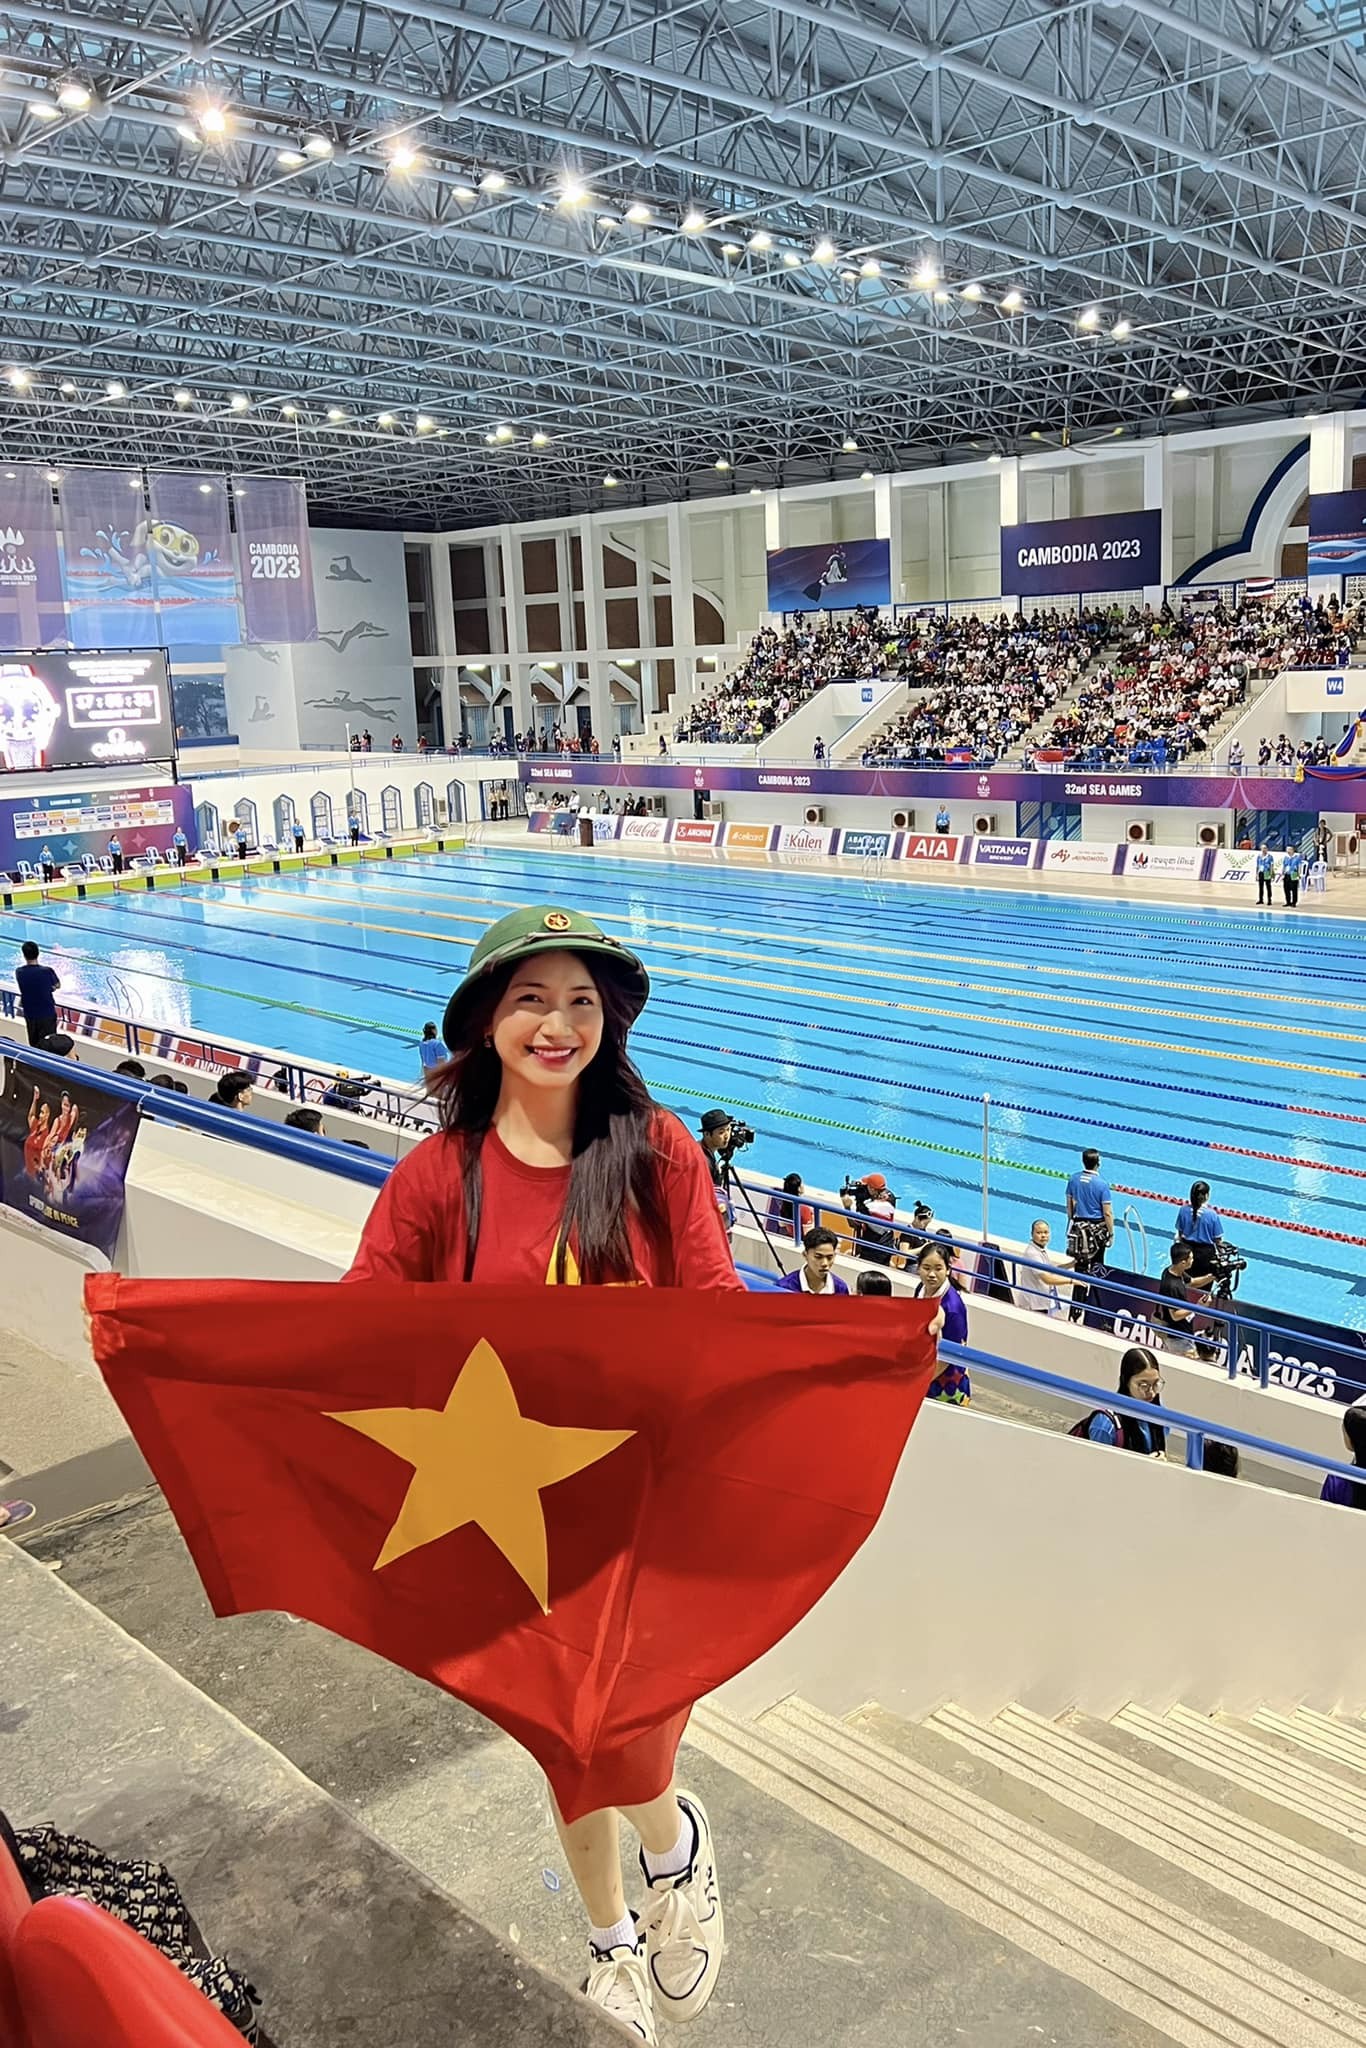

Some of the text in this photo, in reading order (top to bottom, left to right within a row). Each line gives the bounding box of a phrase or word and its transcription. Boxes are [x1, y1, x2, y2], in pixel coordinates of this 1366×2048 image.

[249, 543, 299, 555] CAMBODIA
[1017, 539, 1140, 567] CAMBODIA 2023
[250, 555, 301, 579] 2023
[1328, 680, 1343, 691] W4
[758, 775, 811, 786] CAMBODIA 2023
[1064, 783, 1142, 798] 32nd SEA GAMES
[789, 833, 823, 849] Kulen
[913, 839, 949, 858] AIA
[979, 845, 1029, 856] VATTANAC
[1220, 870, 1250, 881] FBT
[1268, 1351, 1337, 1399] 2023
